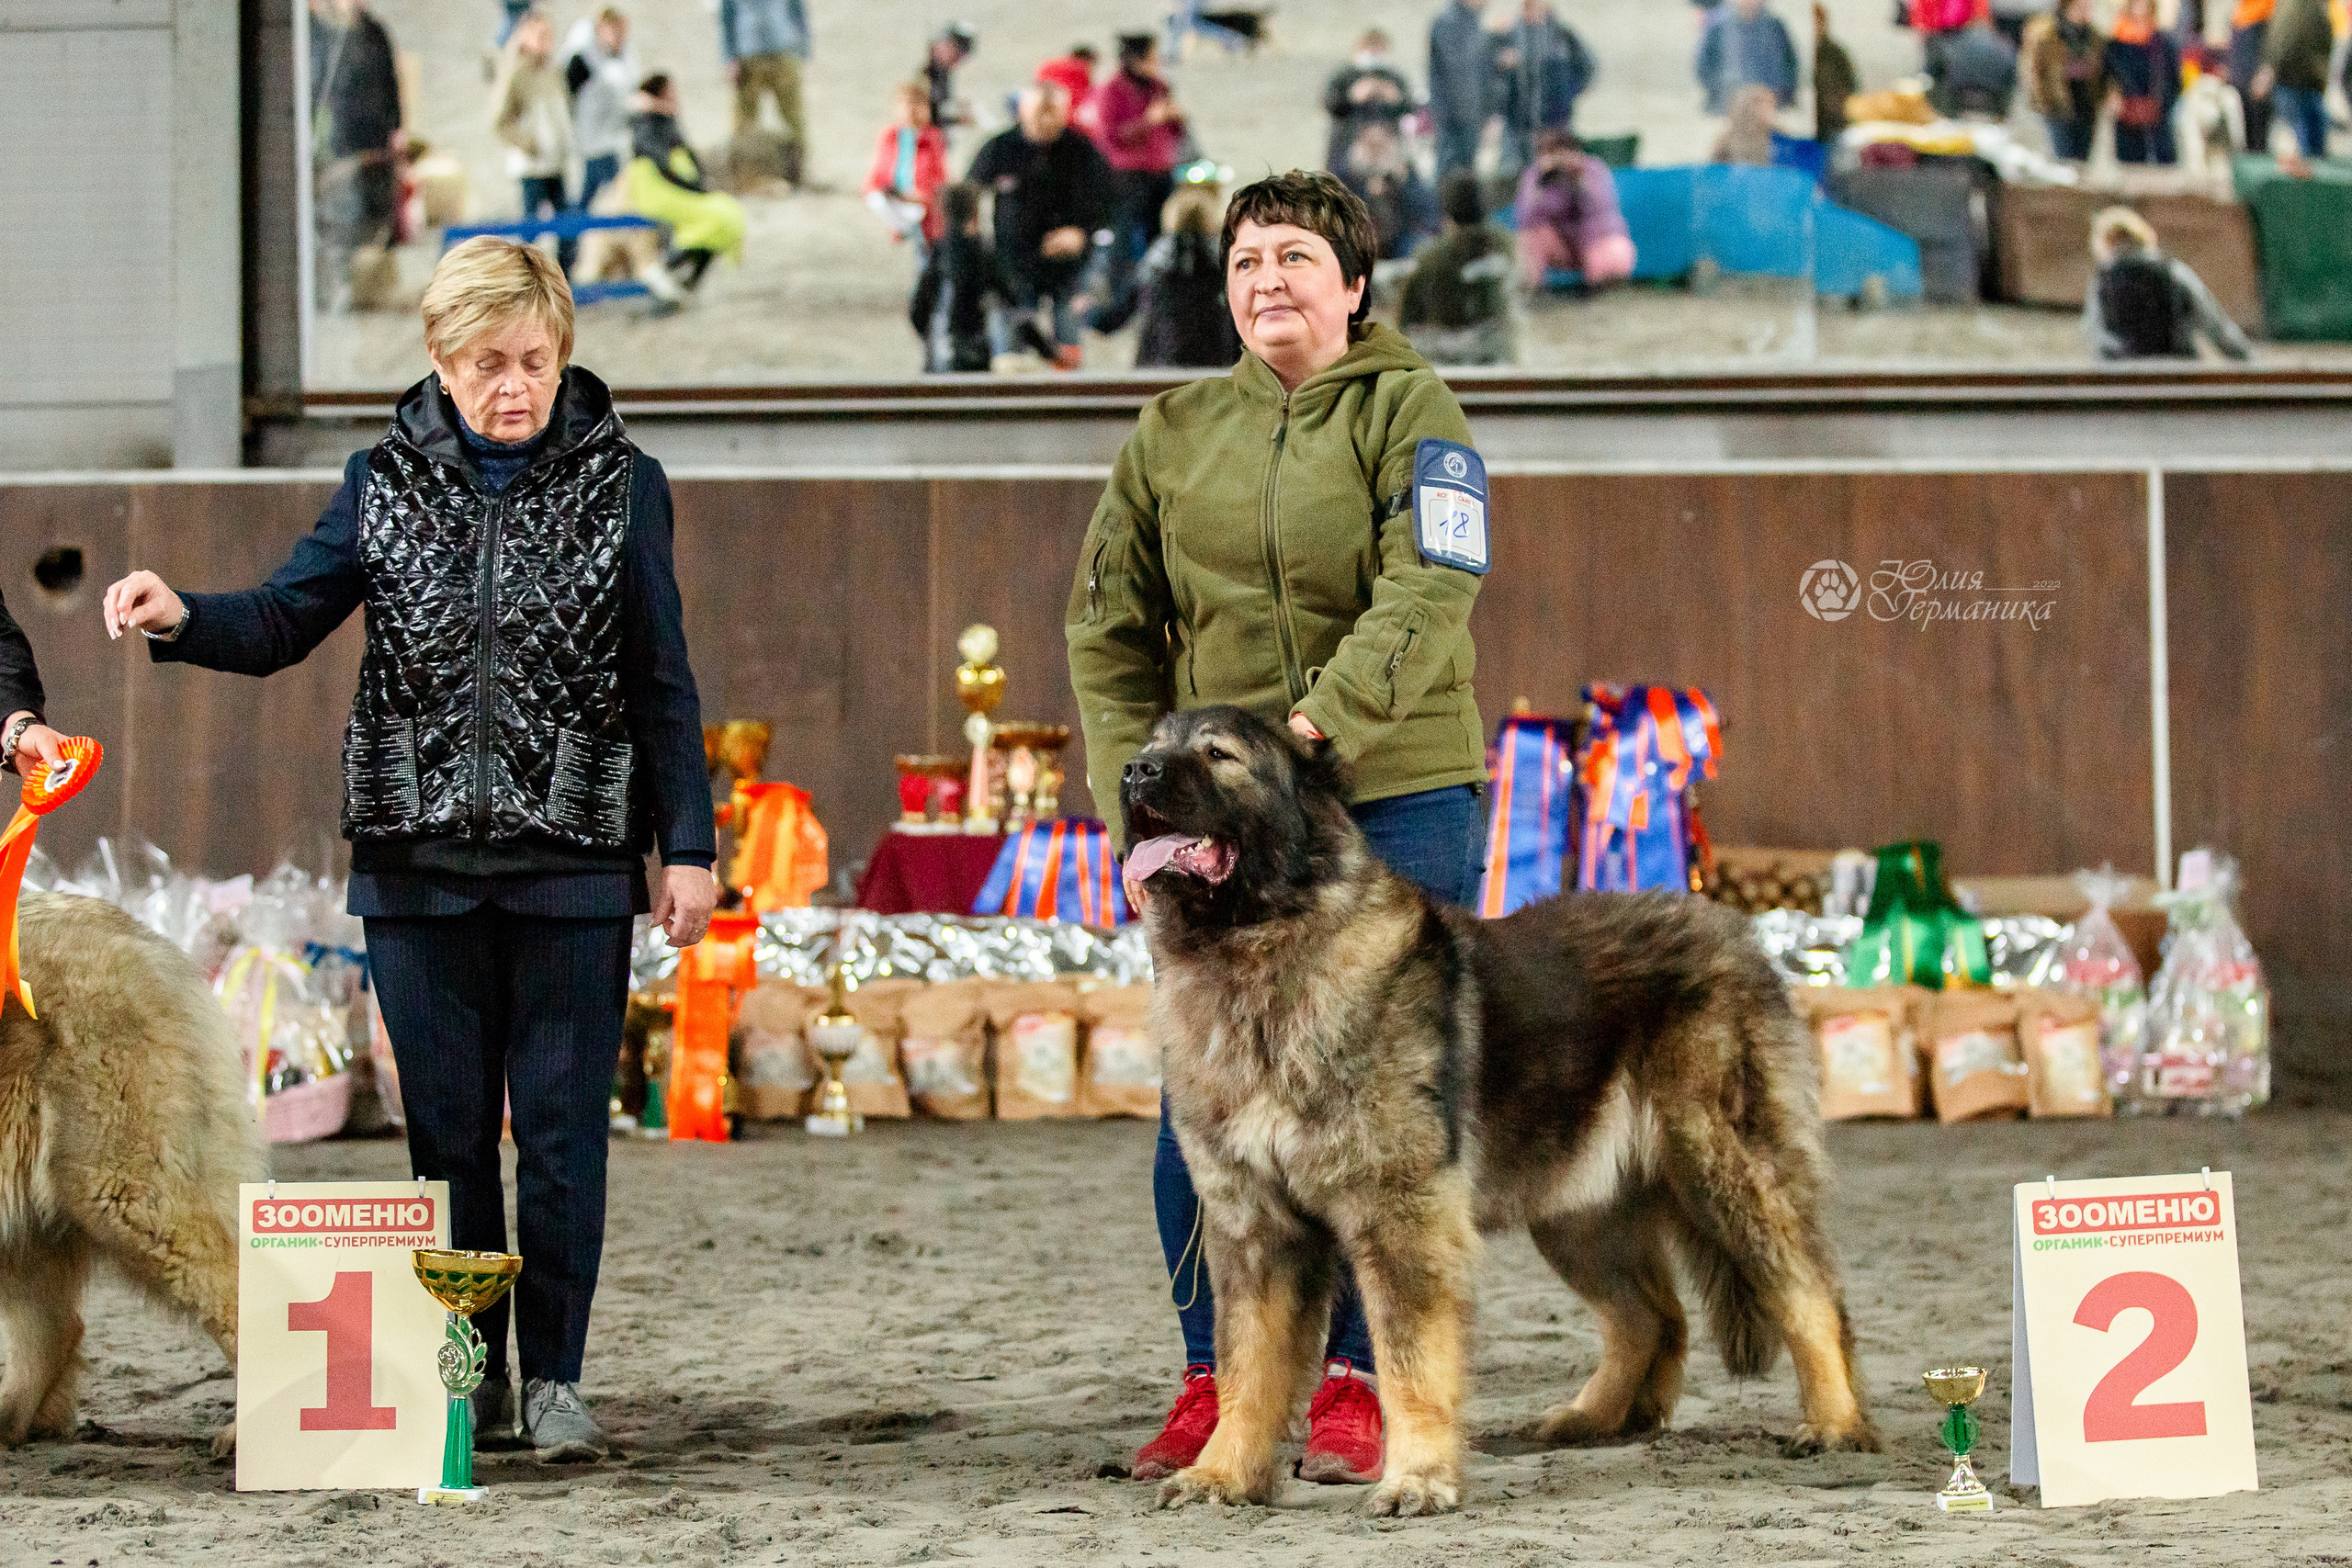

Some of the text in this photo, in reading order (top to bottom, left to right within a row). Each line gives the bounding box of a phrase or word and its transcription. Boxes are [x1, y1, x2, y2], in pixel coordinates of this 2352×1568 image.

[1439, 511, 1469, 537] 18
[257, 1203, 429, 1227] ЗООМЕНЮ
[2038, 1196, 2215, 1229] ЗООМЕНЮ
[288, 1271, 397, 1431] 1
[2073, 1270, 2208, 1443] 2
